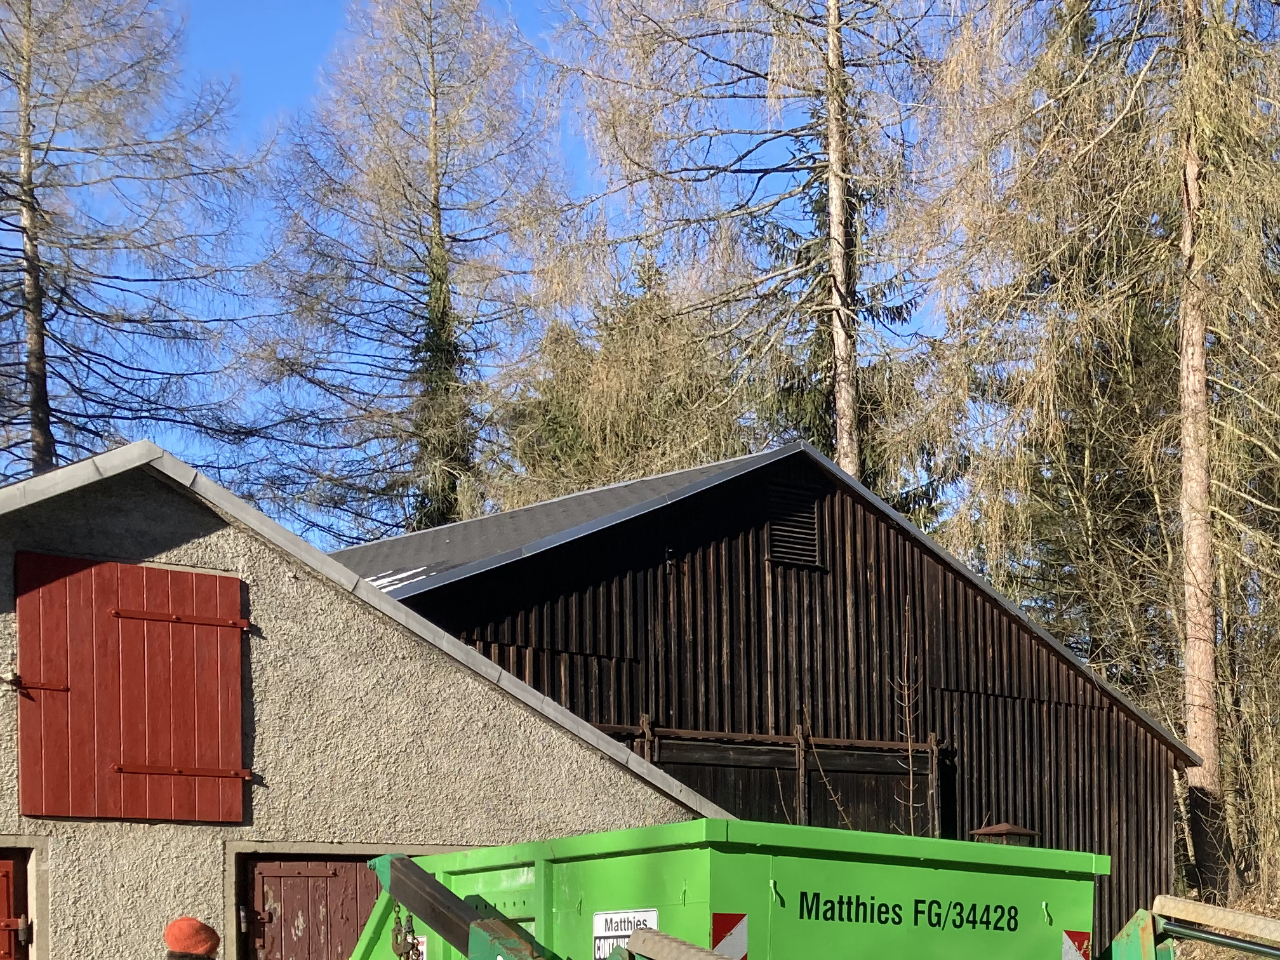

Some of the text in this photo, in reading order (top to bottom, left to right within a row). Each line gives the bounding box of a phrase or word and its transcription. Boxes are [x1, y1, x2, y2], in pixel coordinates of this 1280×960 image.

[604, 916, 648, 932] Matthies
[799, 891, 1019, 931] Matthies FG/34428
